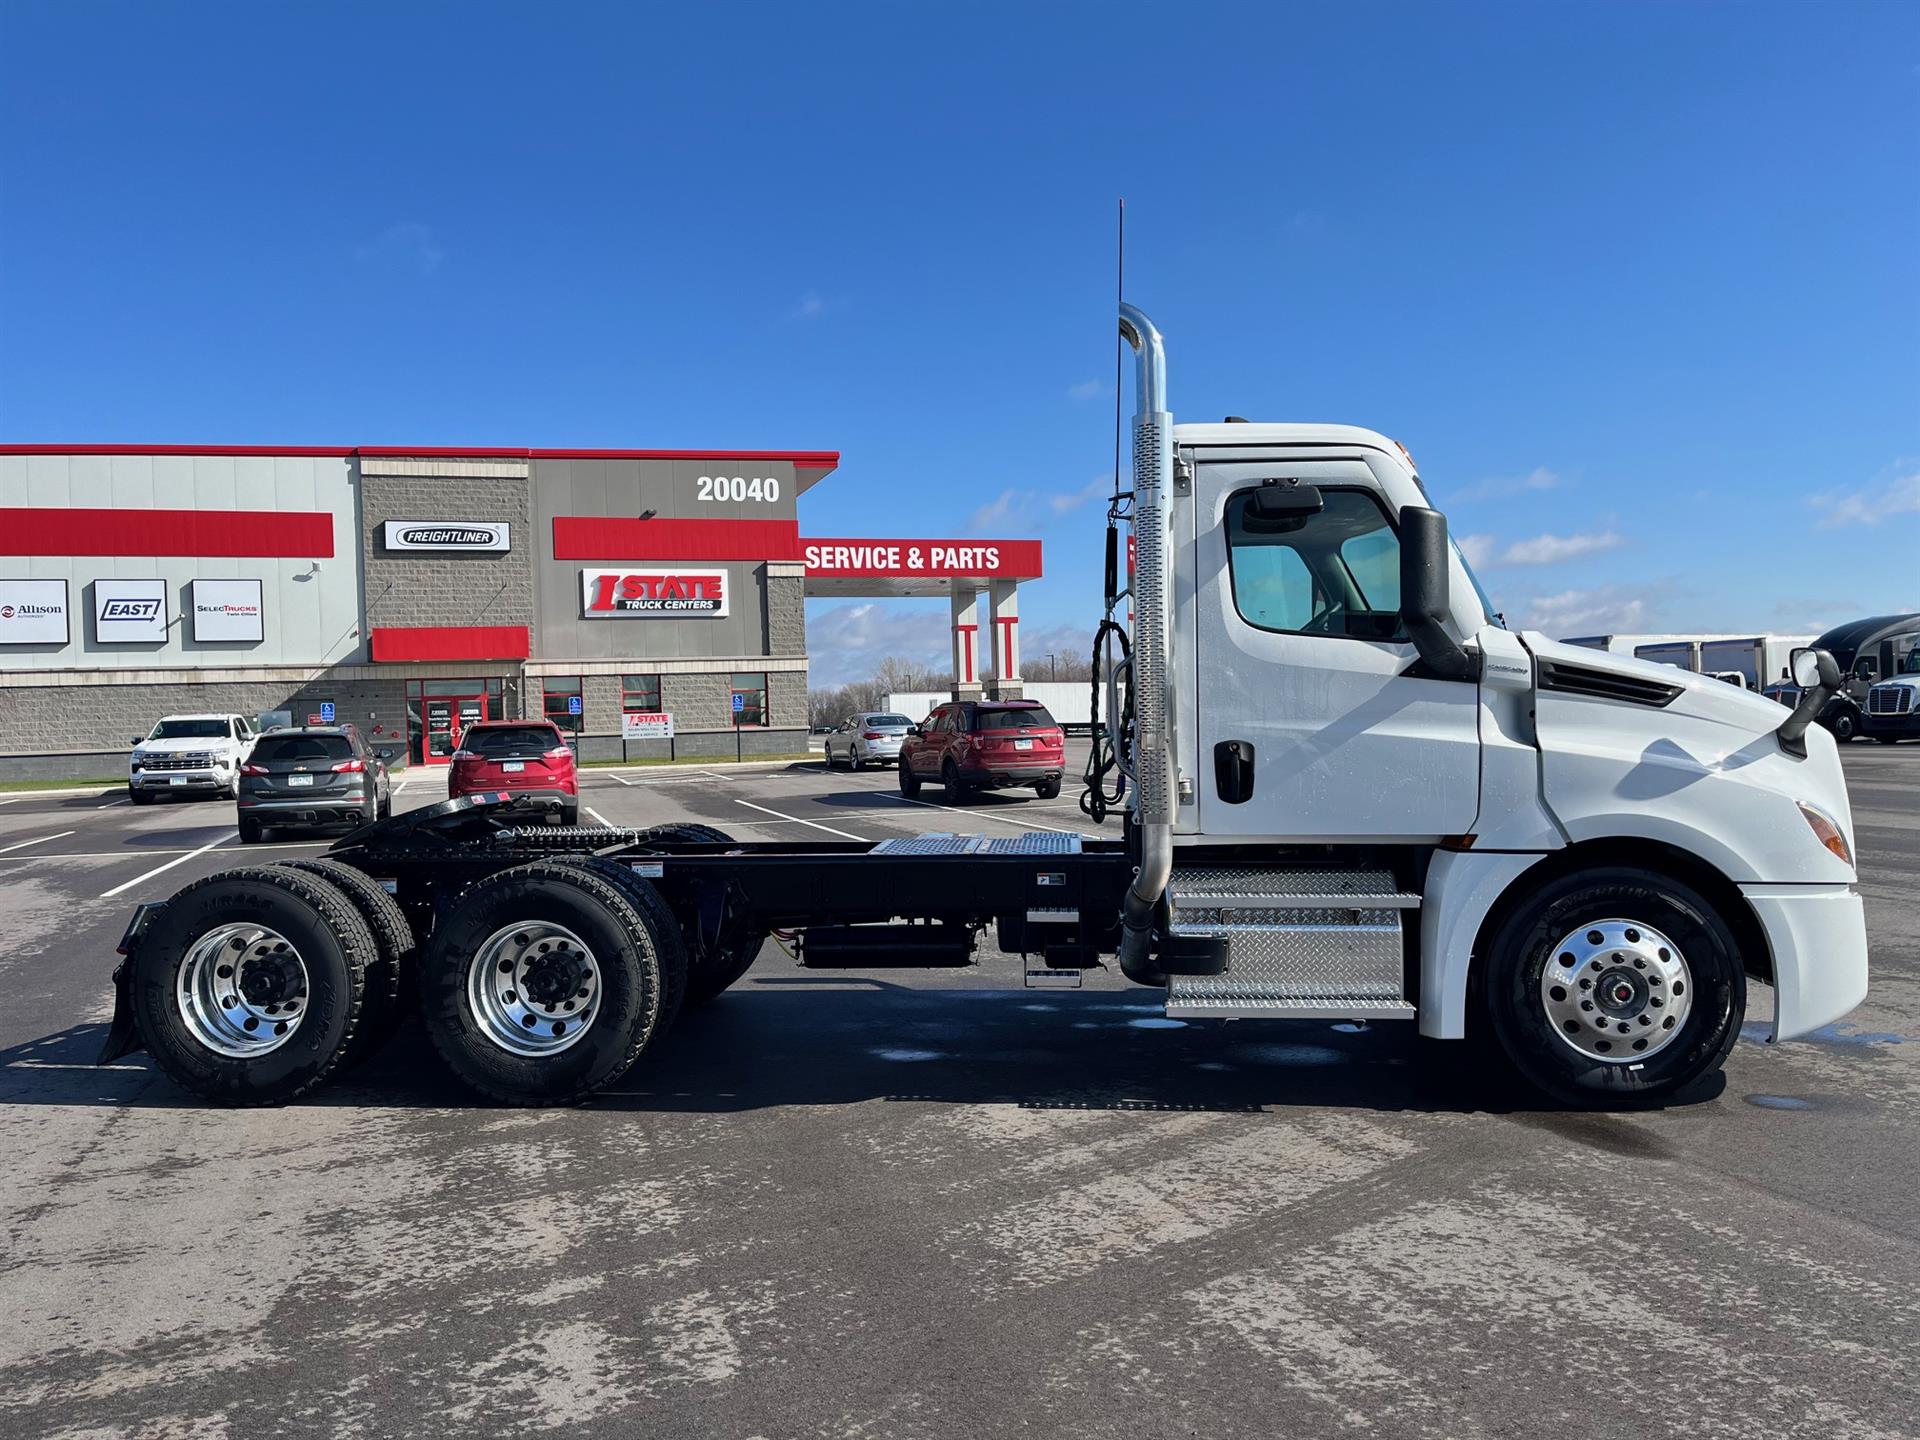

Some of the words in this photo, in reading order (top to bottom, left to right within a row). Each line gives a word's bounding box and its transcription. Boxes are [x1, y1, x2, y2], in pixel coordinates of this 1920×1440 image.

[697, 476, 780, 502] 20040
[406, 530, 490, 542] FREIGHTLINER
[805, 546, 900, 569] SERVICE
[907, 547, 924, 569] &
[931, 547, 1000, 569] PARTS
[18, 604, 62, 614] Allison
[108, 604, 153, 616] EAST
[625, 600, 662, 610] TRUCK
[668, 600, 714, 610] CENTERS
